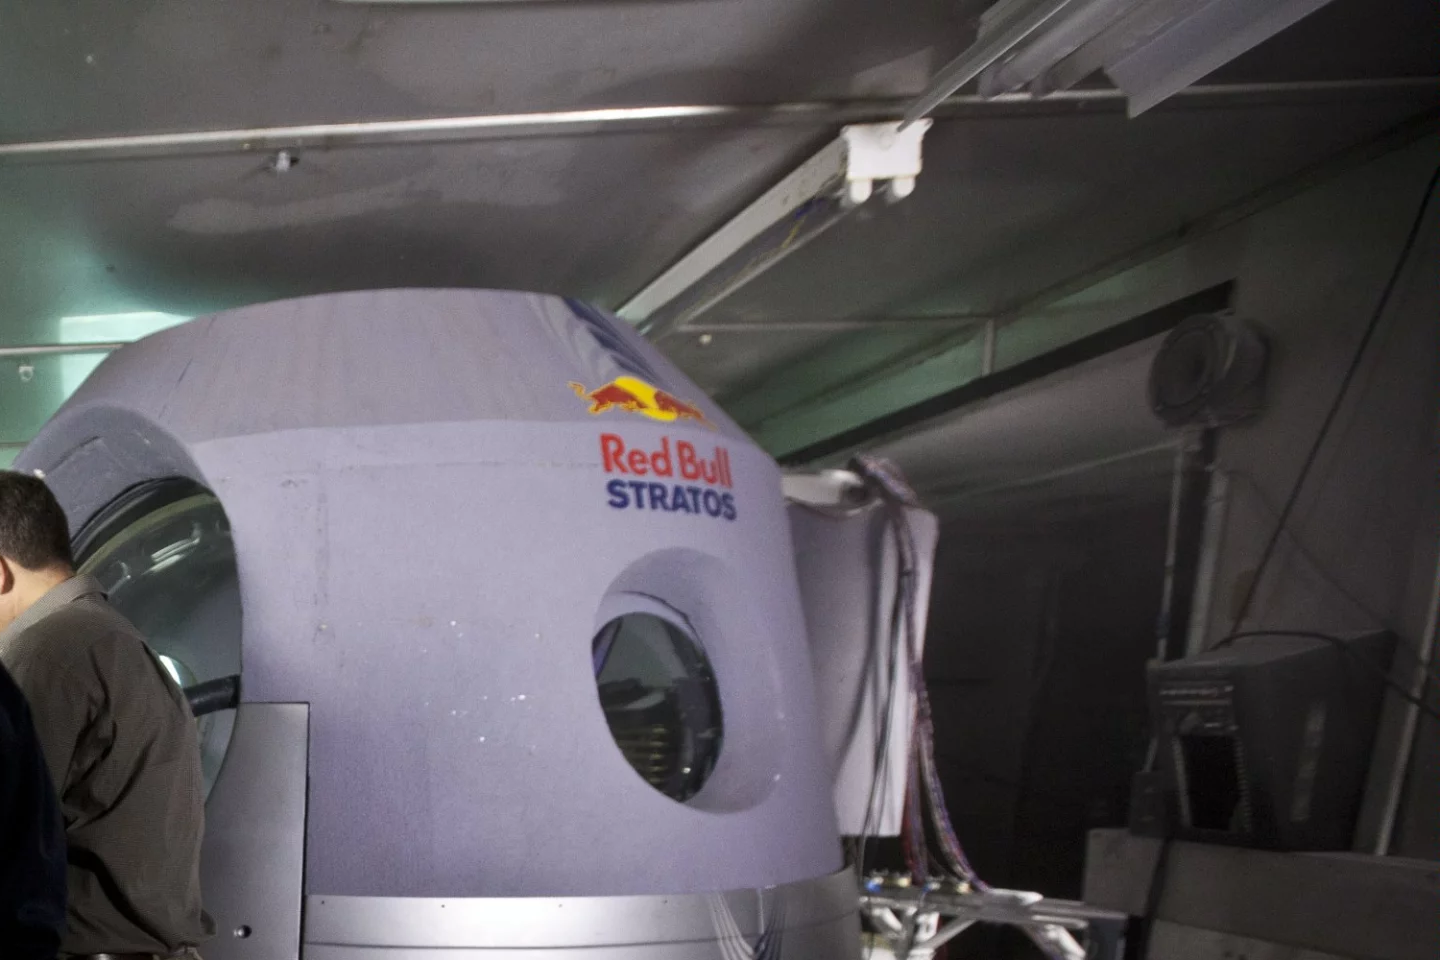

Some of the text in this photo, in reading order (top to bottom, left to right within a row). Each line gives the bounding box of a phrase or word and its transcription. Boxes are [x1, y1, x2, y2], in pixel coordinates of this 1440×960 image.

[600, 432, 733, 489] Red Bull
[606, 478, 737, 521] STRATOS
